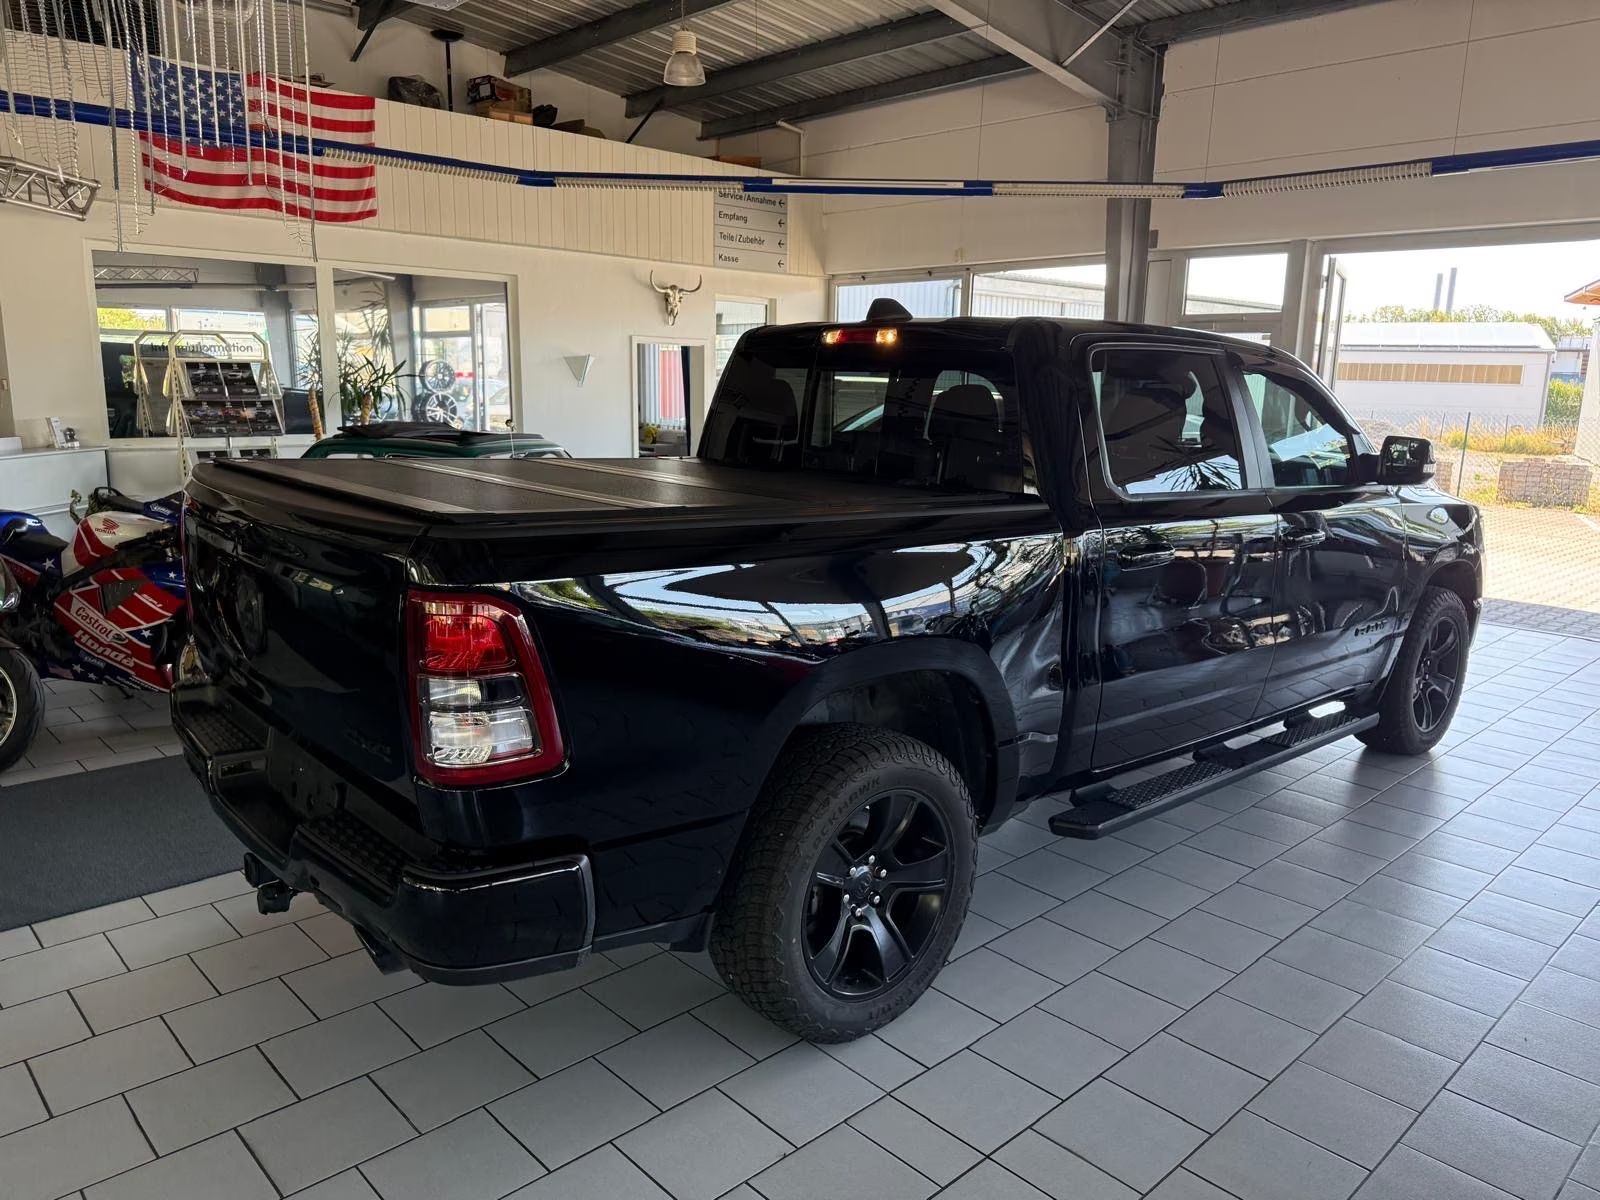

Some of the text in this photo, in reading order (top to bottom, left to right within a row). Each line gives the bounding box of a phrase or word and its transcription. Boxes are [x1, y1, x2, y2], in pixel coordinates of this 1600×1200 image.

[718, 210, 748, 224] Empfang
[718, 253, 740, 263] Kasse
[75, 606, 113, 641] Castrol
[74, 629, 135, 668] Honda
